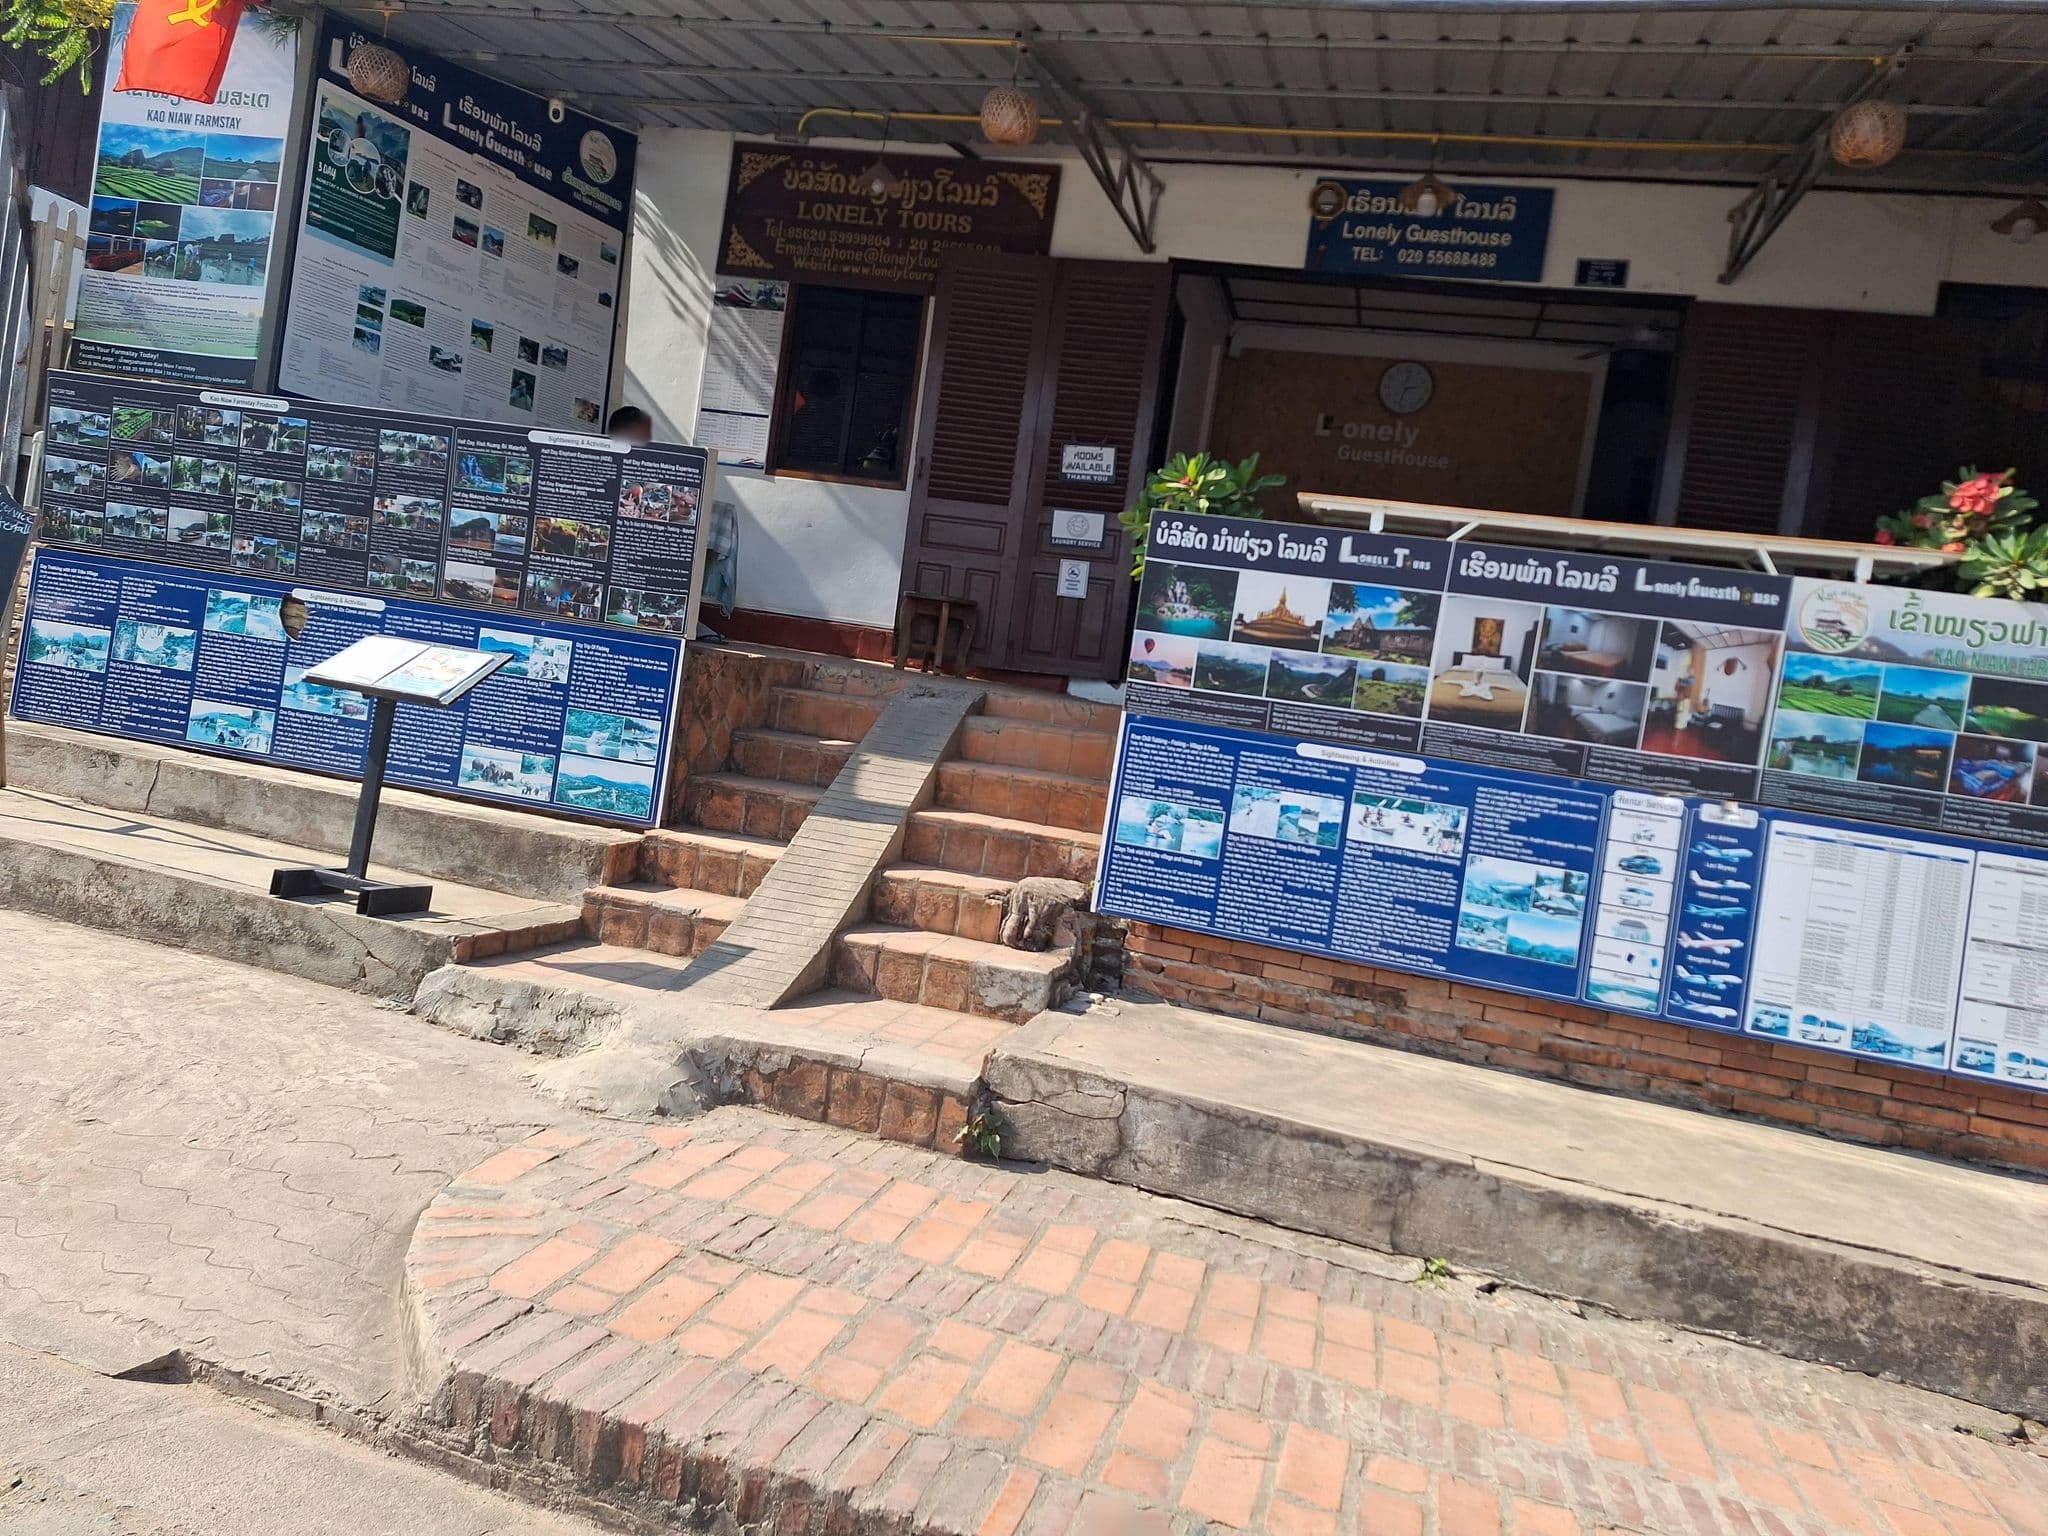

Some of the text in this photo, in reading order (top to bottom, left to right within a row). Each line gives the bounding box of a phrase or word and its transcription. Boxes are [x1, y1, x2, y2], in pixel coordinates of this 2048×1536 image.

[147, 109, 242, 129] KAO NIAW FARMSTAY
[797, 201, 973, 234] LONELY TOURS
[1342, 221, 1513, 247] Lonely Guesthouse
[1352, 246, 1383, 262] TEL:
[1397, 248, 1423, 264] 020
[111, 347, 138, 358] Farmstay
[140, 351, 159, 360] Today!
[233, 397, 255, 407] Farmstay
[257, 401, 278, 409] Products
[1315, 412, 1419, 449] Lonely
[586, 440, 611, 449] Activities
[1338, 444, 1449, 469] GuestHouse
[1066, 473, 1091, 481] THANK
[1077, 540, 1101, 548] SERVICE
[1935, 648, 1965, 666] KAO
[1971, 652, 2009, 672] NIAW
[1368, 756, 1399, 767] Activities
